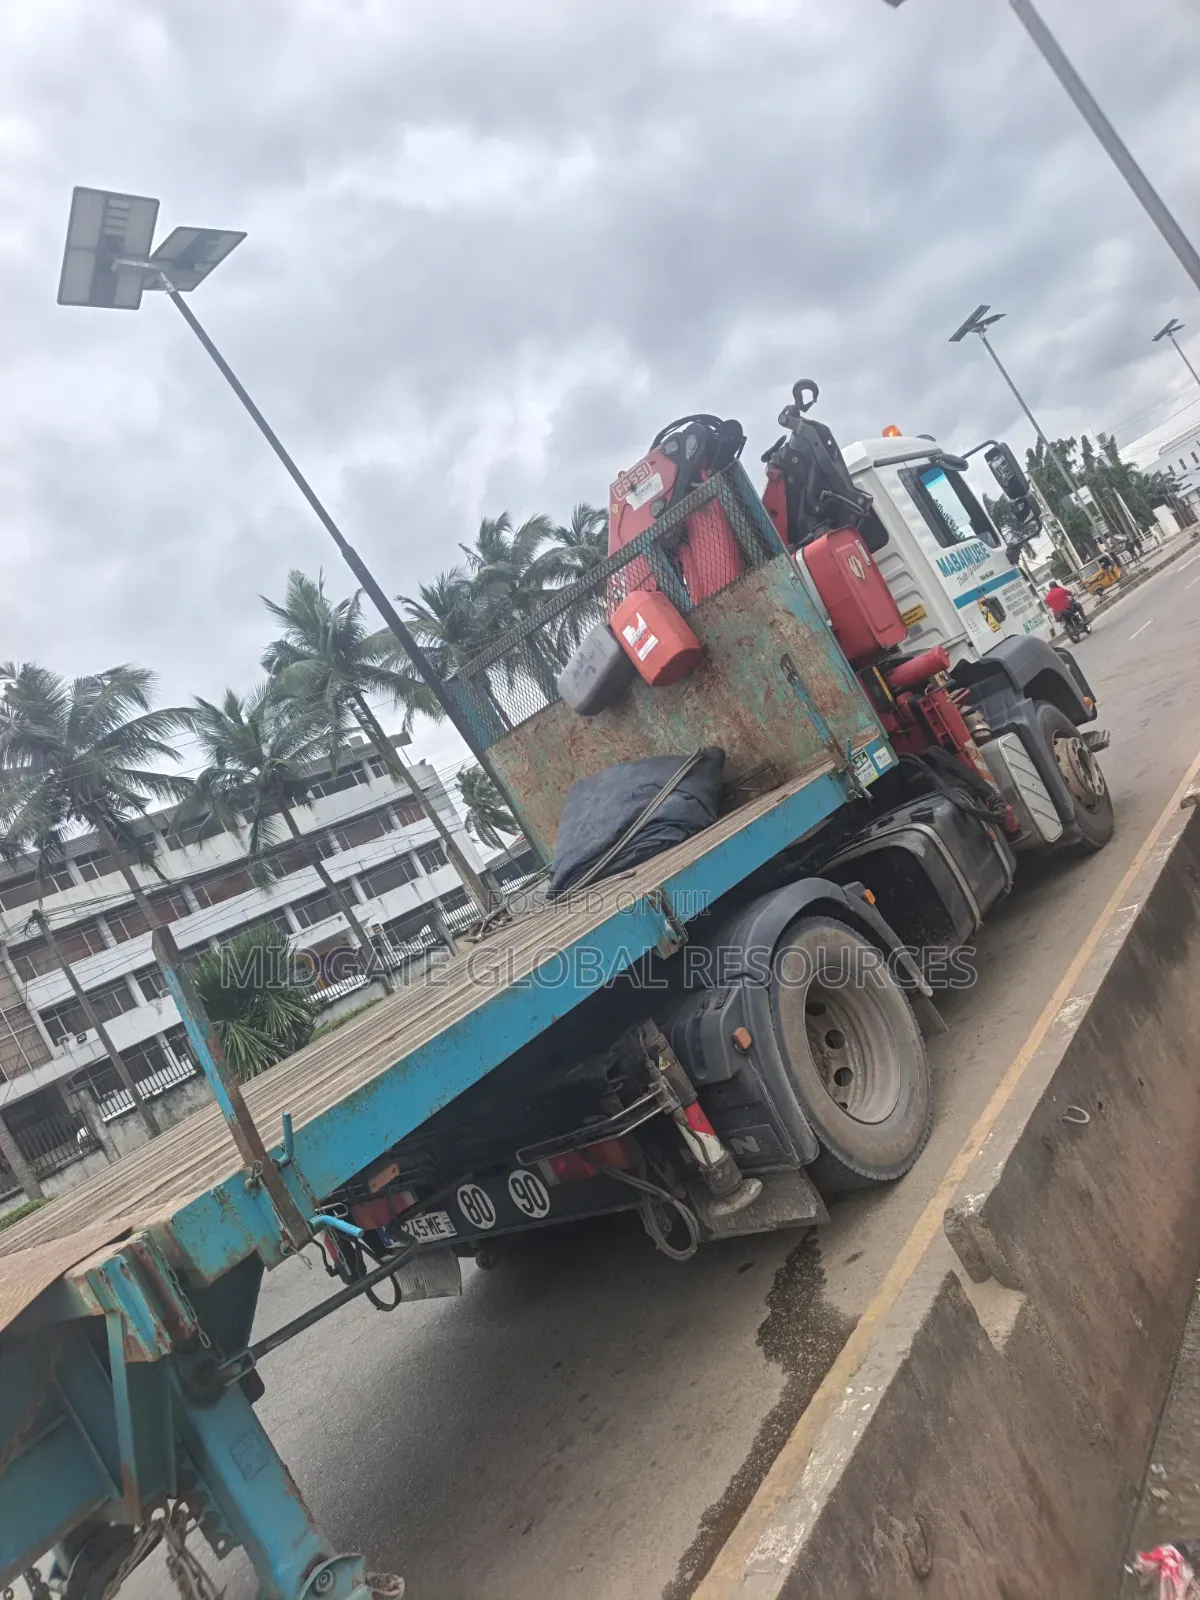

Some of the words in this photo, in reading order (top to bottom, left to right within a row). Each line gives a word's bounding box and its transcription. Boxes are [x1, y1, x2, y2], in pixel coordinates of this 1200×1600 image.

[614, 464, 650, 498] FASSI
[459, 1187, 494, 1225] 80
[510, 1174, 548, 1214] 90
